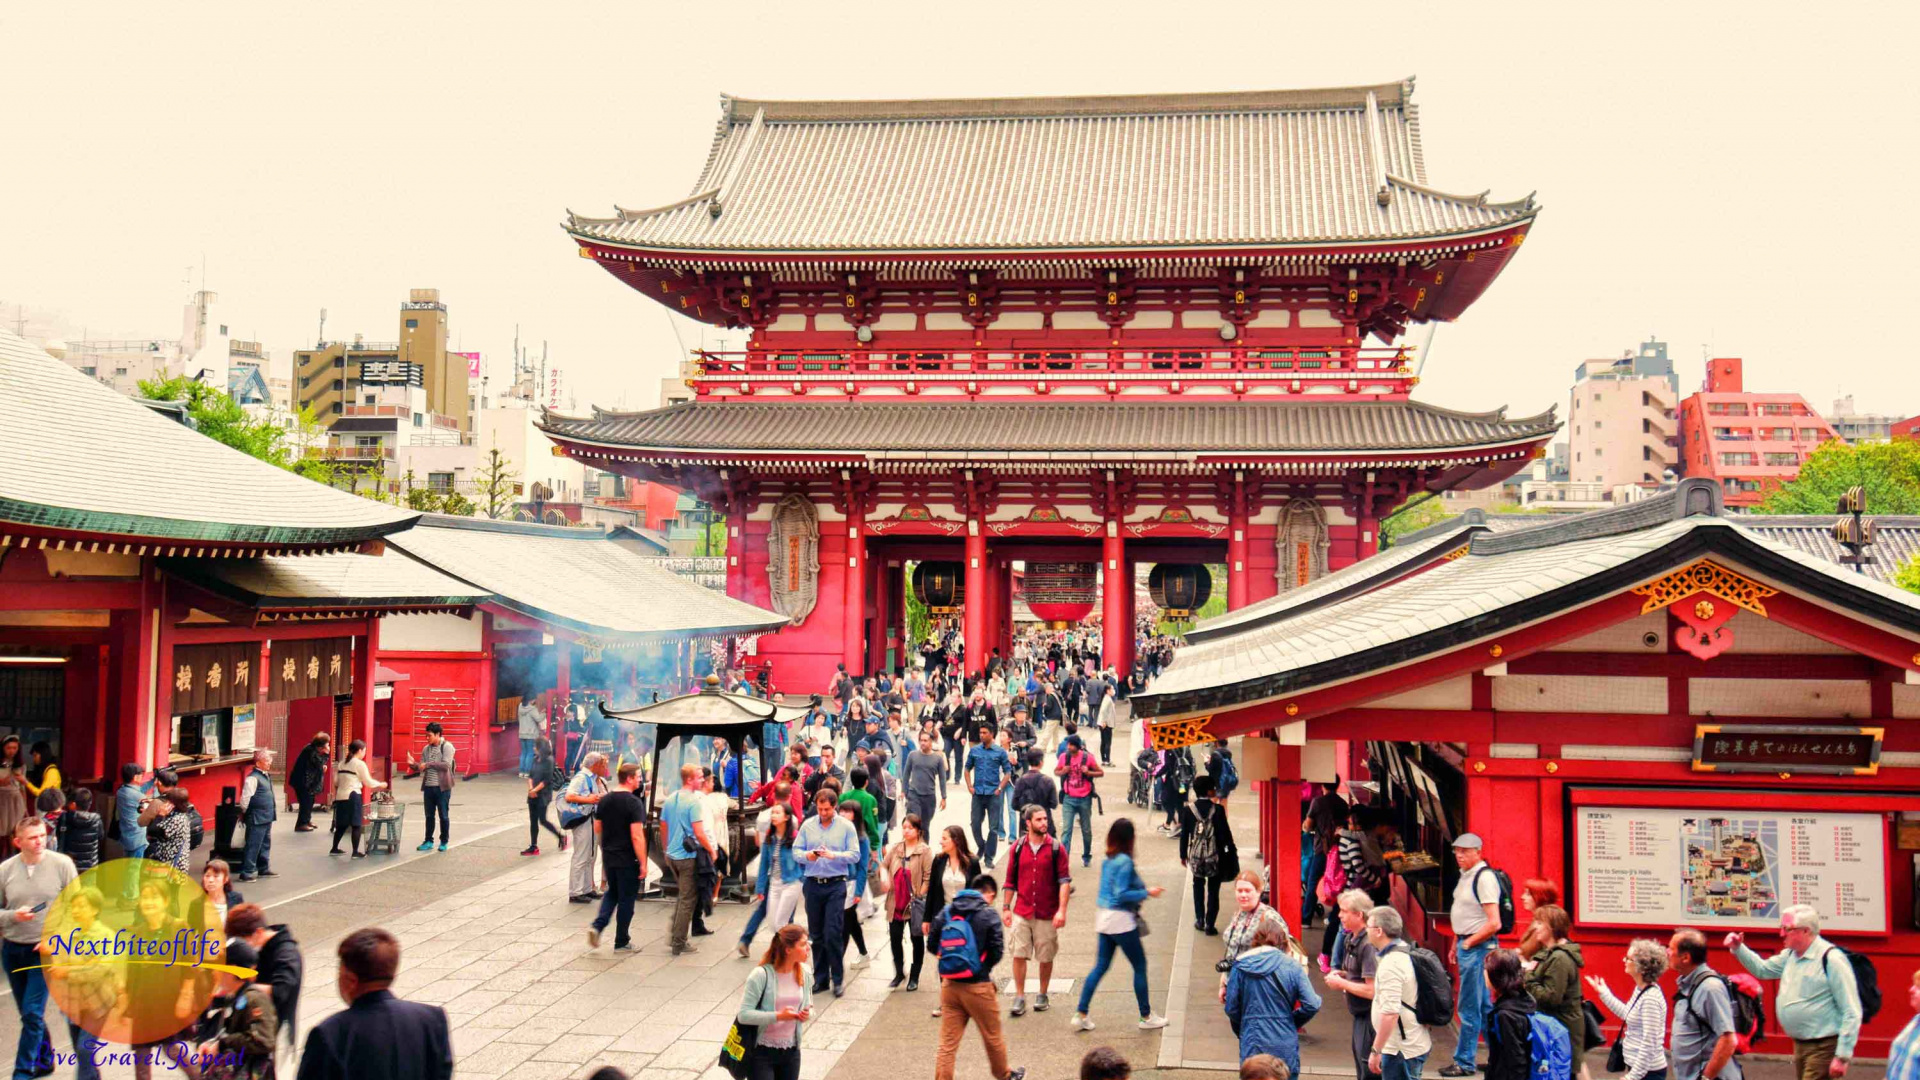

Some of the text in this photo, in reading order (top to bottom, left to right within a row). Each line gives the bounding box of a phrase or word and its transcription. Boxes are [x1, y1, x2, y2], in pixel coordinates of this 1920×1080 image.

[550, 368, 558, 406] カラオケ
[176, 660, 249, 692] 授香所
[282, 654, 341, 682] 授香所
